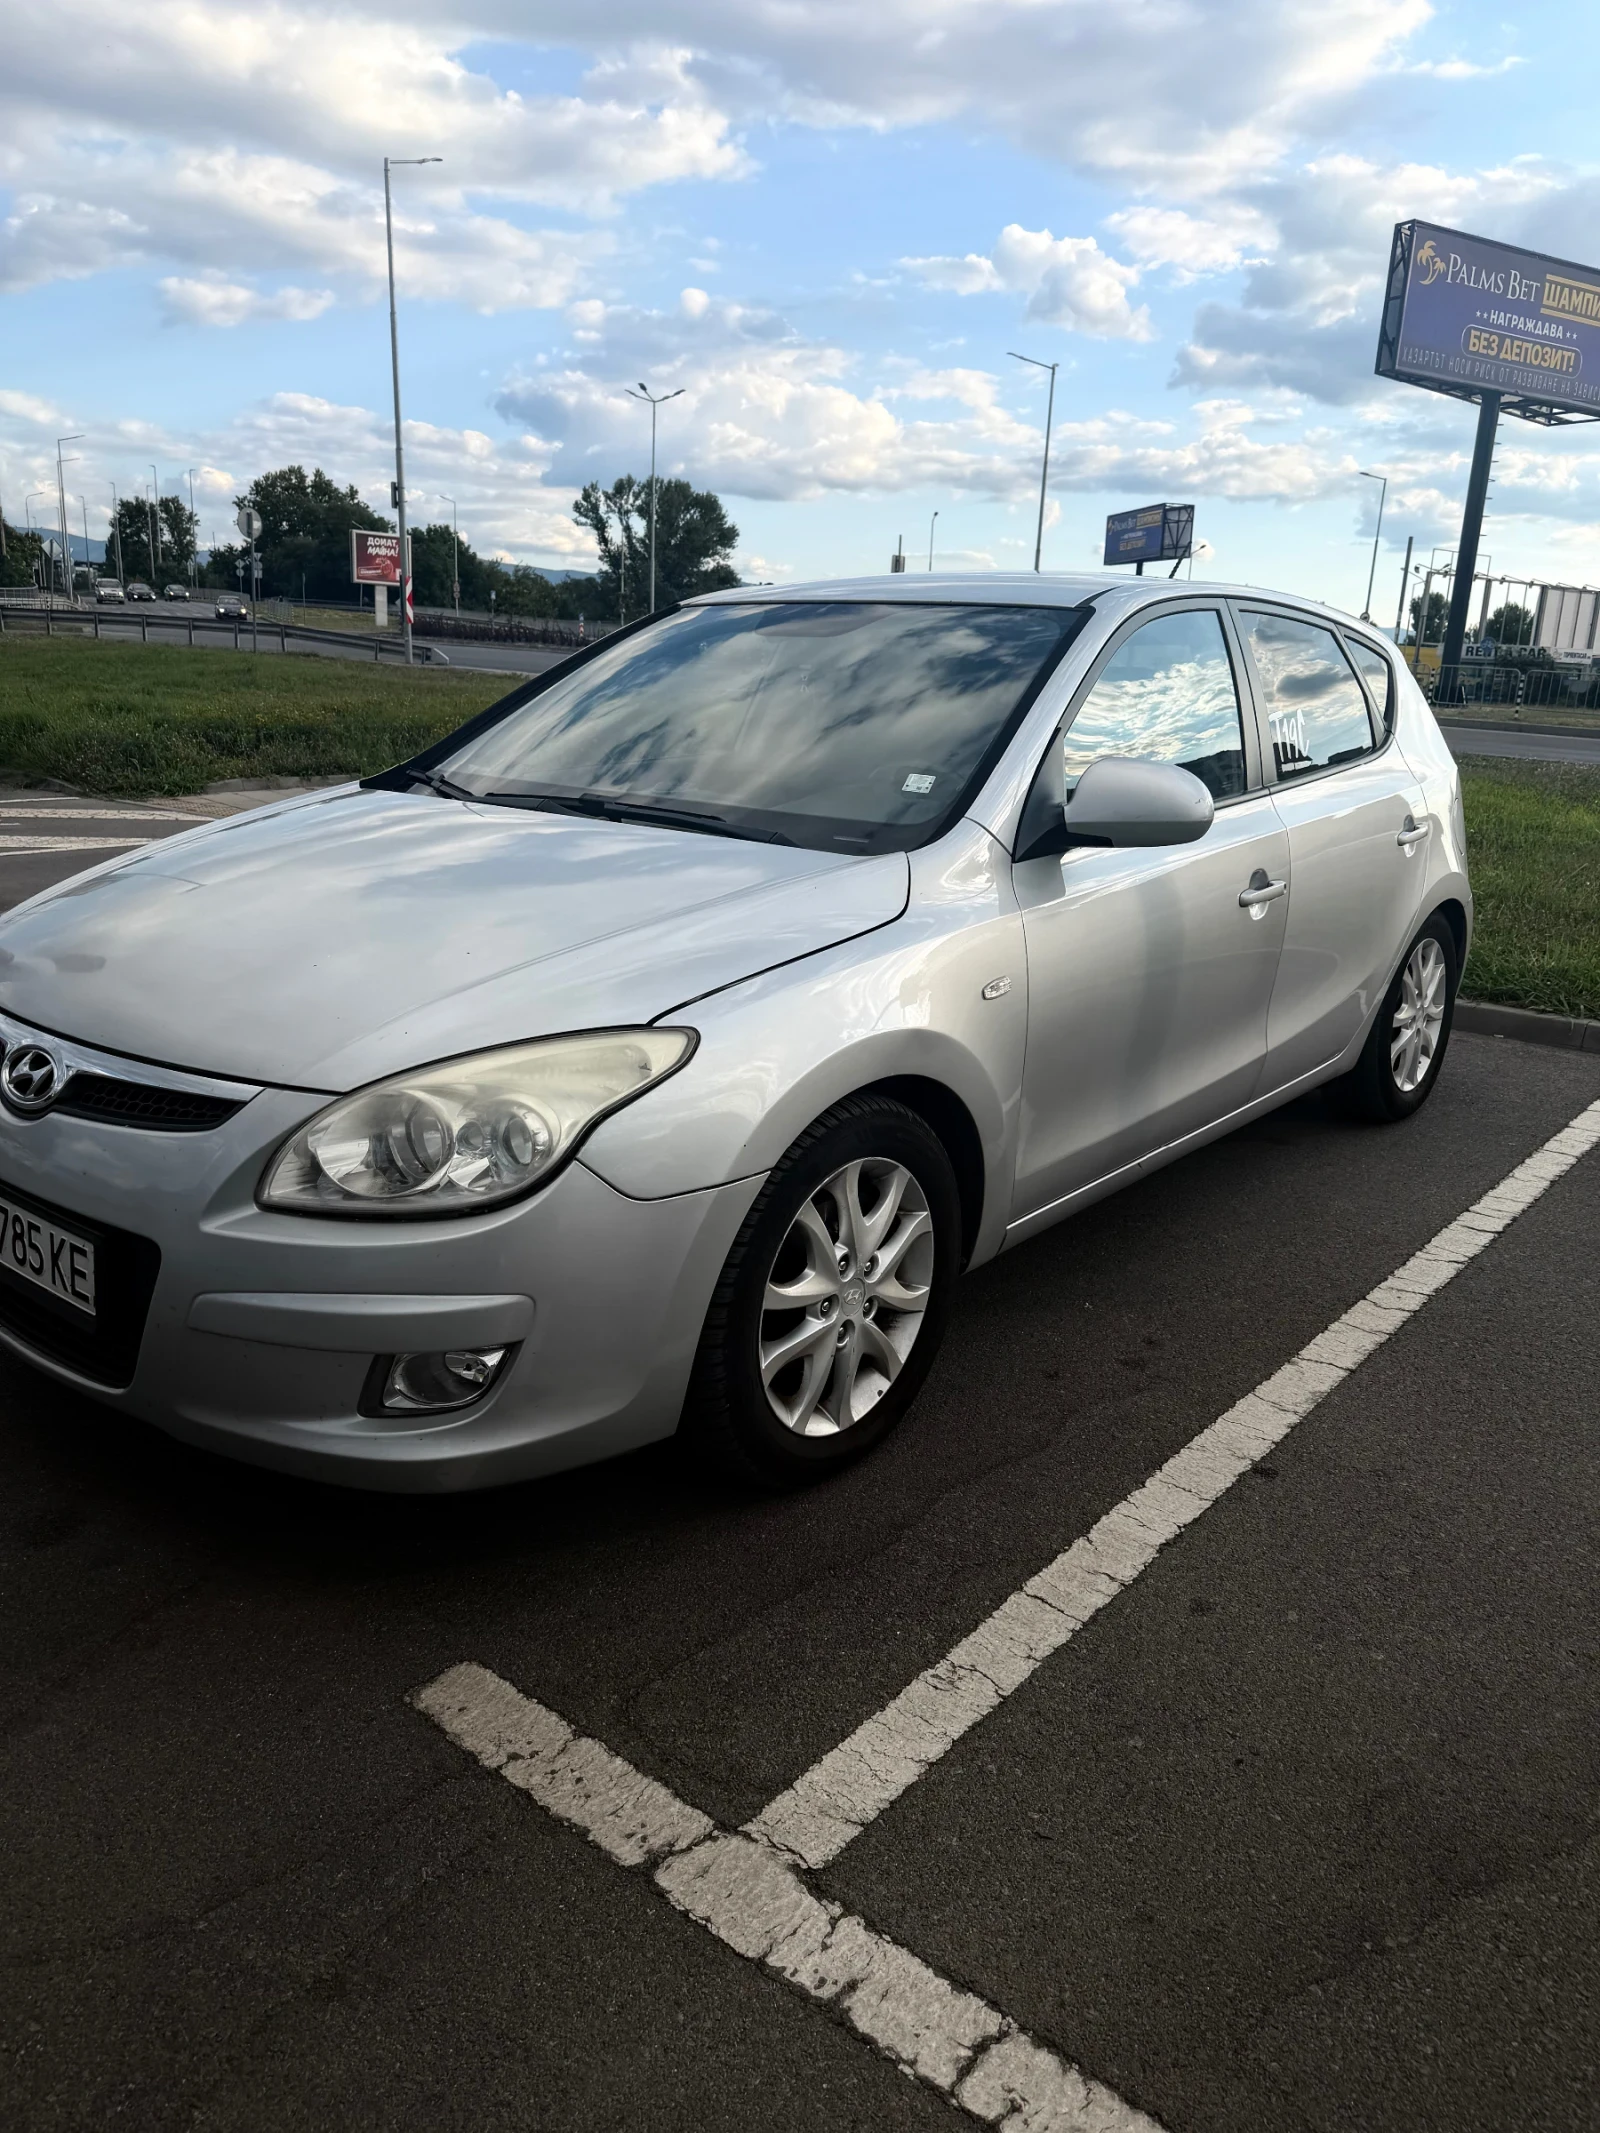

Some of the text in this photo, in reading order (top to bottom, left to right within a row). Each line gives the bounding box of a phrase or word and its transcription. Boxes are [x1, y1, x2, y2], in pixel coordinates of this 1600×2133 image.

[1446, 253, 1540, 301] PALMS BET
[1490, 310, 1563, 339] НАГРАЖДАВА
[1402, 346, 1600, 401] ХАЗАРТЪТ НОСИ РИСК ОТ РАЗВИВАНЕ НА ЗАВИС
[1469, 330, 1575, 372] БЕЗ ДЕПОЗИТ!
